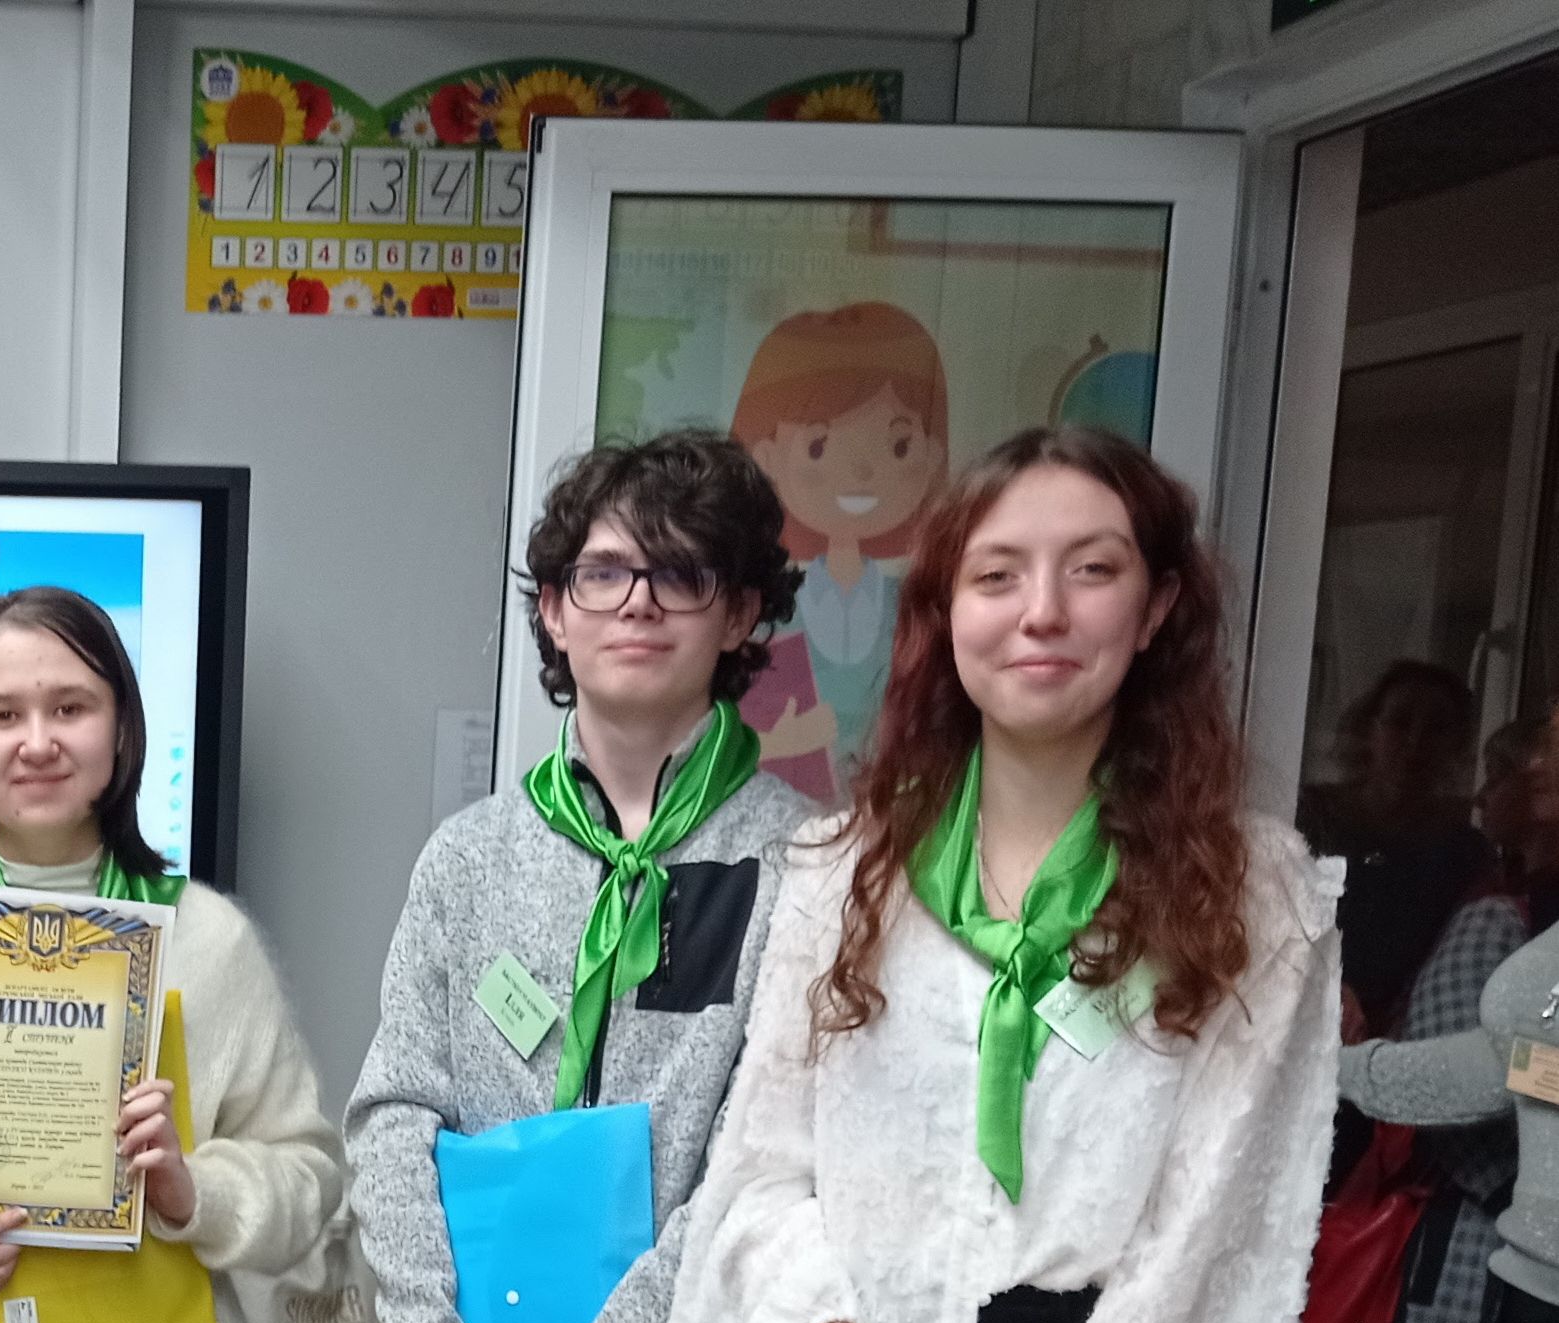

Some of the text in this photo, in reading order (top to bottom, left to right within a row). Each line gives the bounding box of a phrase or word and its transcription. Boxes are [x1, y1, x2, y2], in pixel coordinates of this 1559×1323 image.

[247, 154, 270, 211] 1
[306, 157, 337, 212] 2
[369, 159, 404, 214] 3
[431, 161, 471, 216] 4
[499, 162, 527, 217] 5
[222, 242, 230, 262] 1
[254, 242, 266, 262] 2
[287, 242, 298, 264] 3
[318, 243, 330, 264] 4
[355, 243, 366, 265] 5
[387, 243, 399, 265] 6
[420, 246, 430, 265] 7
[450, 246, 463, 267] 8
[485, 247, 497, 269] 9
